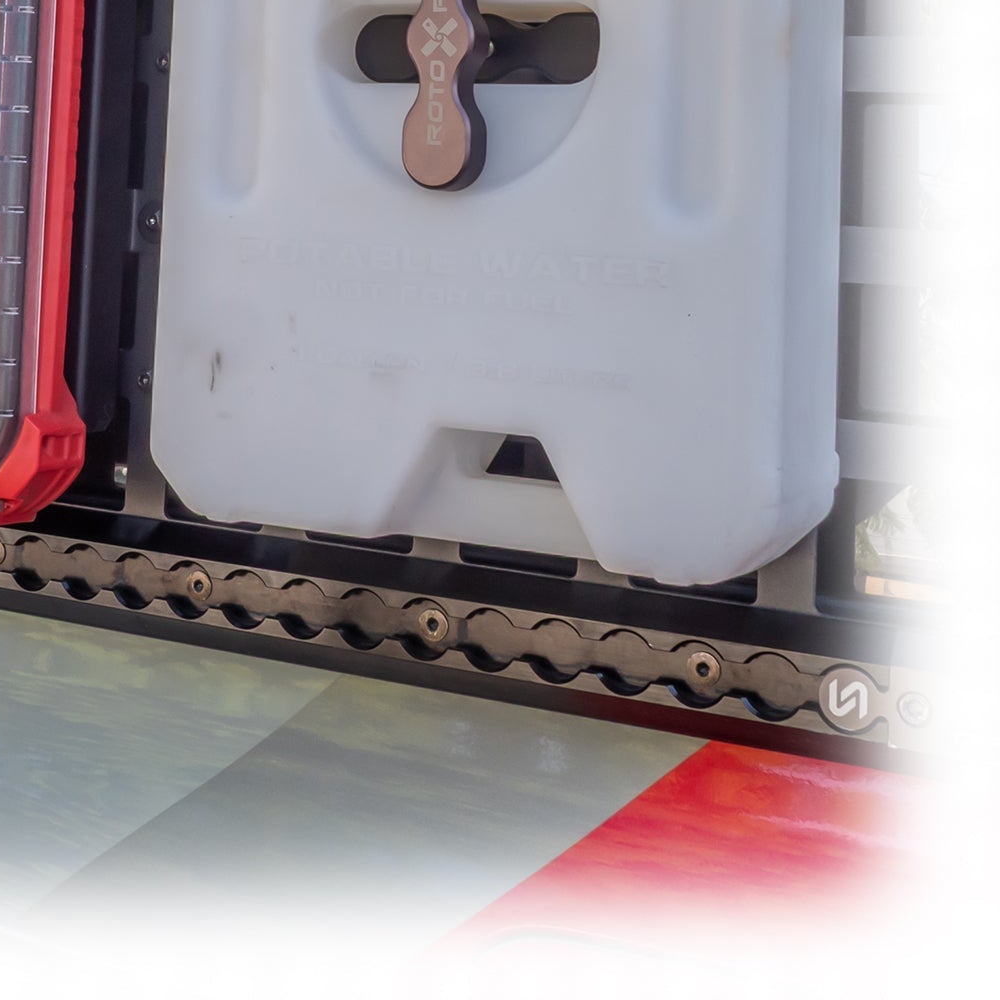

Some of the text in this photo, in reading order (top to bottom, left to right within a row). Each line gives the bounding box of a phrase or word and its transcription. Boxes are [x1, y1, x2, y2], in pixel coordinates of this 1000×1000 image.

[427, 60, 446, 146] ROTO
[240, 238, 670, 288] POTABLE WATER
